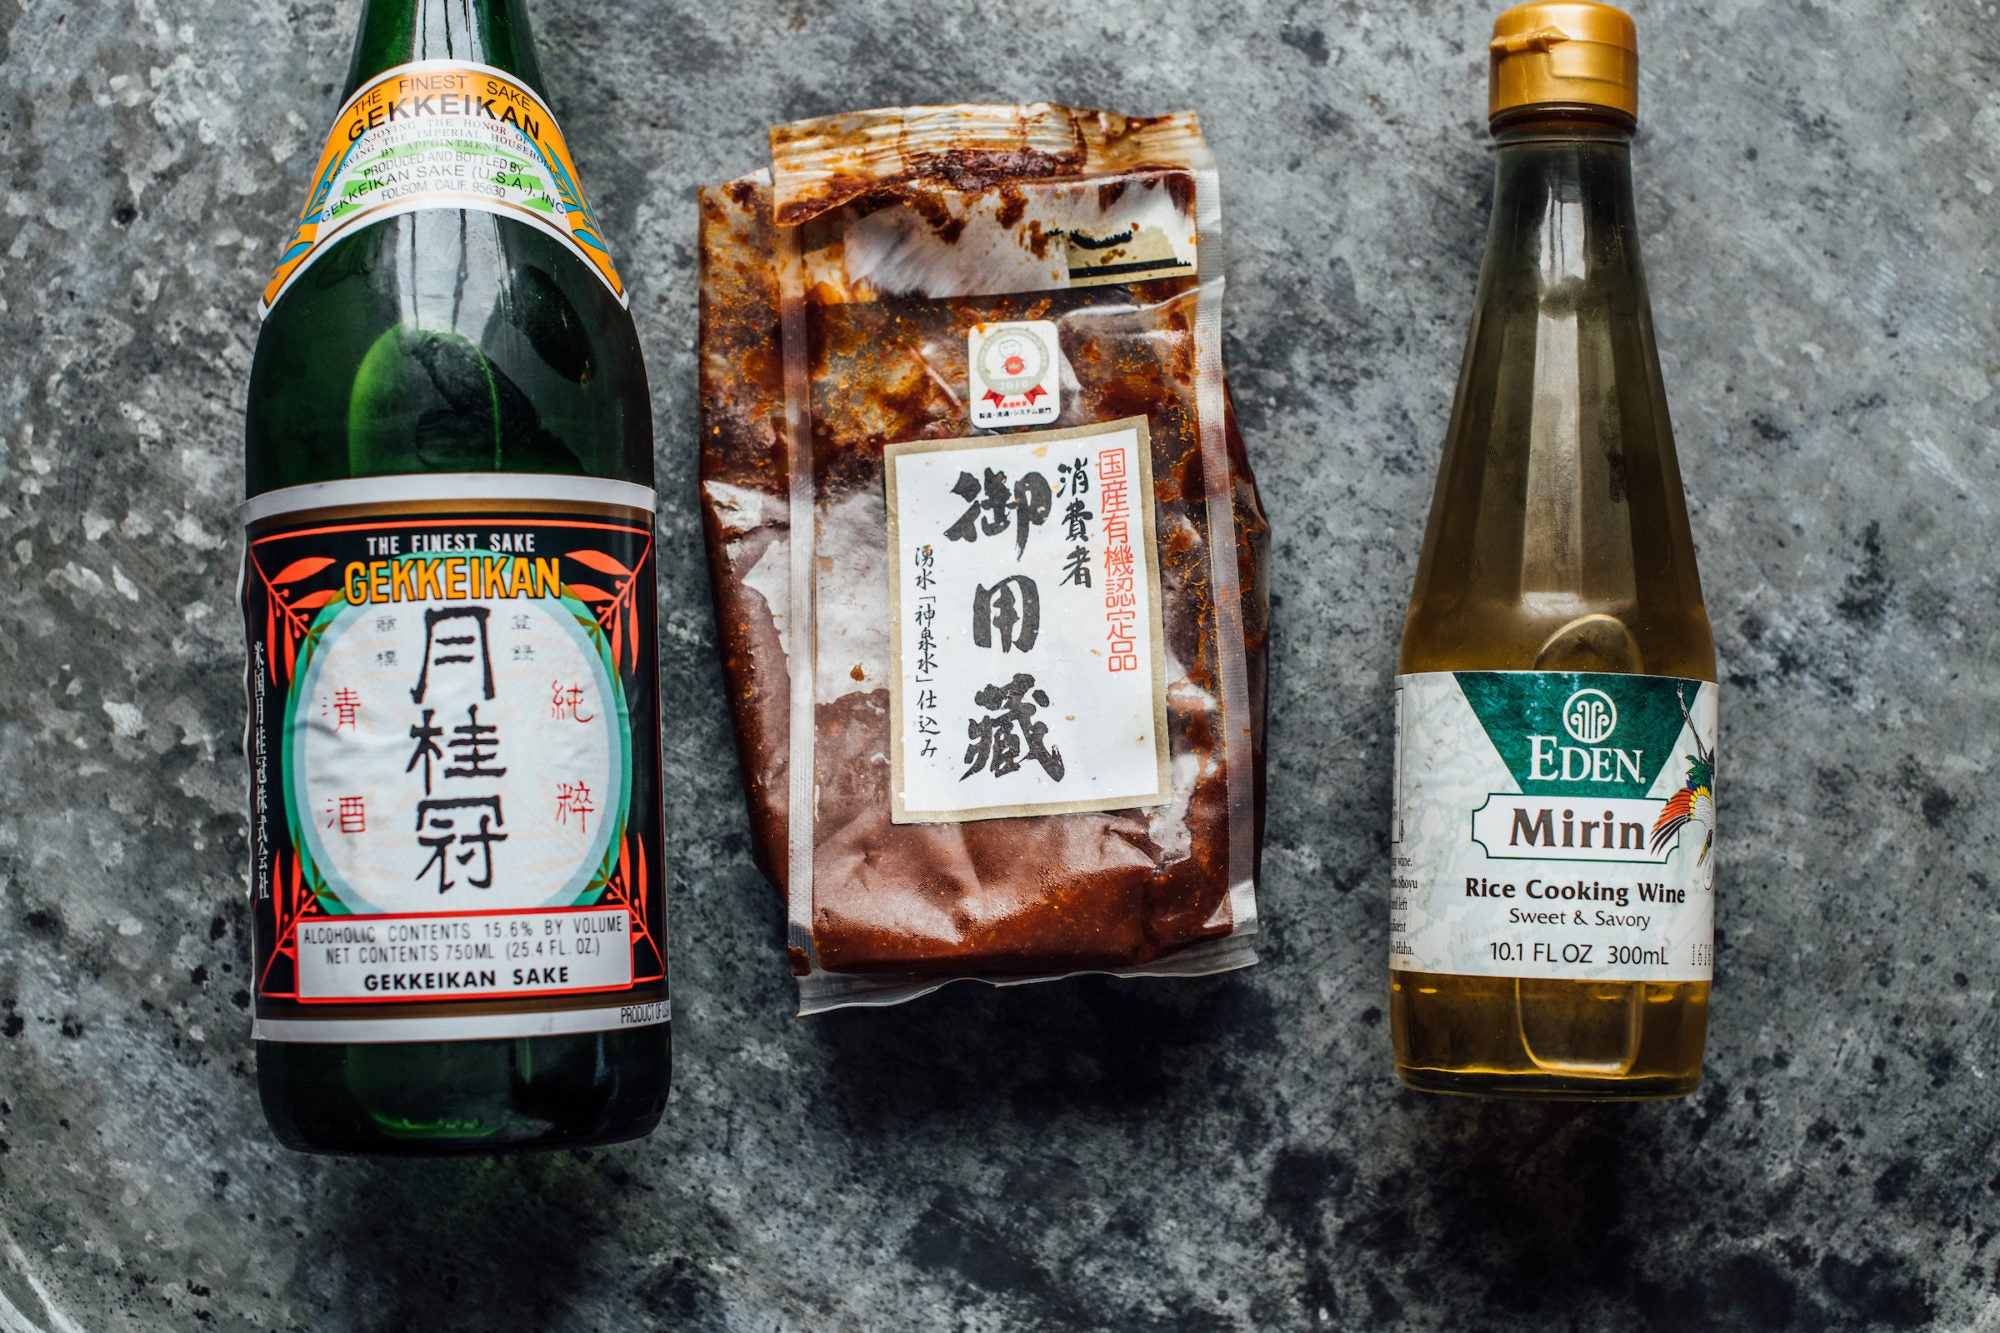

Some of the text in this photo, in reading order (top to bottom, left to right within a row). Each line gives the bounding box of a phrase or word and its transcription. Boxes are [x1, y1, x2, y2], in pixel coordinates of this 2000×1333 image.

[353, 74, 531, 116] THE FINEST SAKE
[347, 93, 540, 142] GEKKEIKAN
[428, 118, 453, 128] THE
[464, 119, 507, 136] HONOR
[515, 132, 529, 145] OF
[381, 138, 500, 158] BY APPOINTMENT
[417, 128, 481, 140] IMPERIAL
[364, 149, 524, 179] PRODUCED AND BOTTLED BY
[321, 168, 410, 223] GEKKEIKAN
[416, 164, 465, 179] SAKE
[541, 191, 568, 218] INC.
[472, 182, 506, 199] 95630
[1056, 456, 1094, 589] 消費者
[366, 532, 536, 557] THE FINEST SAKE
[1098, 447, 1138, 673] 国産有機認定品
[344, 555, 563, 606] GEKKEIKAN
[406, 606, 508, 895] 月桂冠
[1527, 735, 1643, 784] EDEN
[1508, 807, 1645, 850] Mirin
[1465, 877, 1686, 907] Rice Cooking Wine
[304, 915, 622, 944] ALCOHOLIC CONTENTS 15.6% BY VOLUME
[1509, 907, 1651, 932] Sweet & Savory
[326, 947, 350, 965] NET
[359, 944, 439, 964] CONTENTS
[445, 943, 495, 962] 750ML
[506, 940, 543, 962] (25.4
[576, 938, 600, 957] OZ.)
[1490, 941, 1669, 966] 10.1 FL OZ 300mL
[364, 966, 569, 991] GEKKEIKAN SAKE
[621, 1003, 655, 1024] PRODUCT
